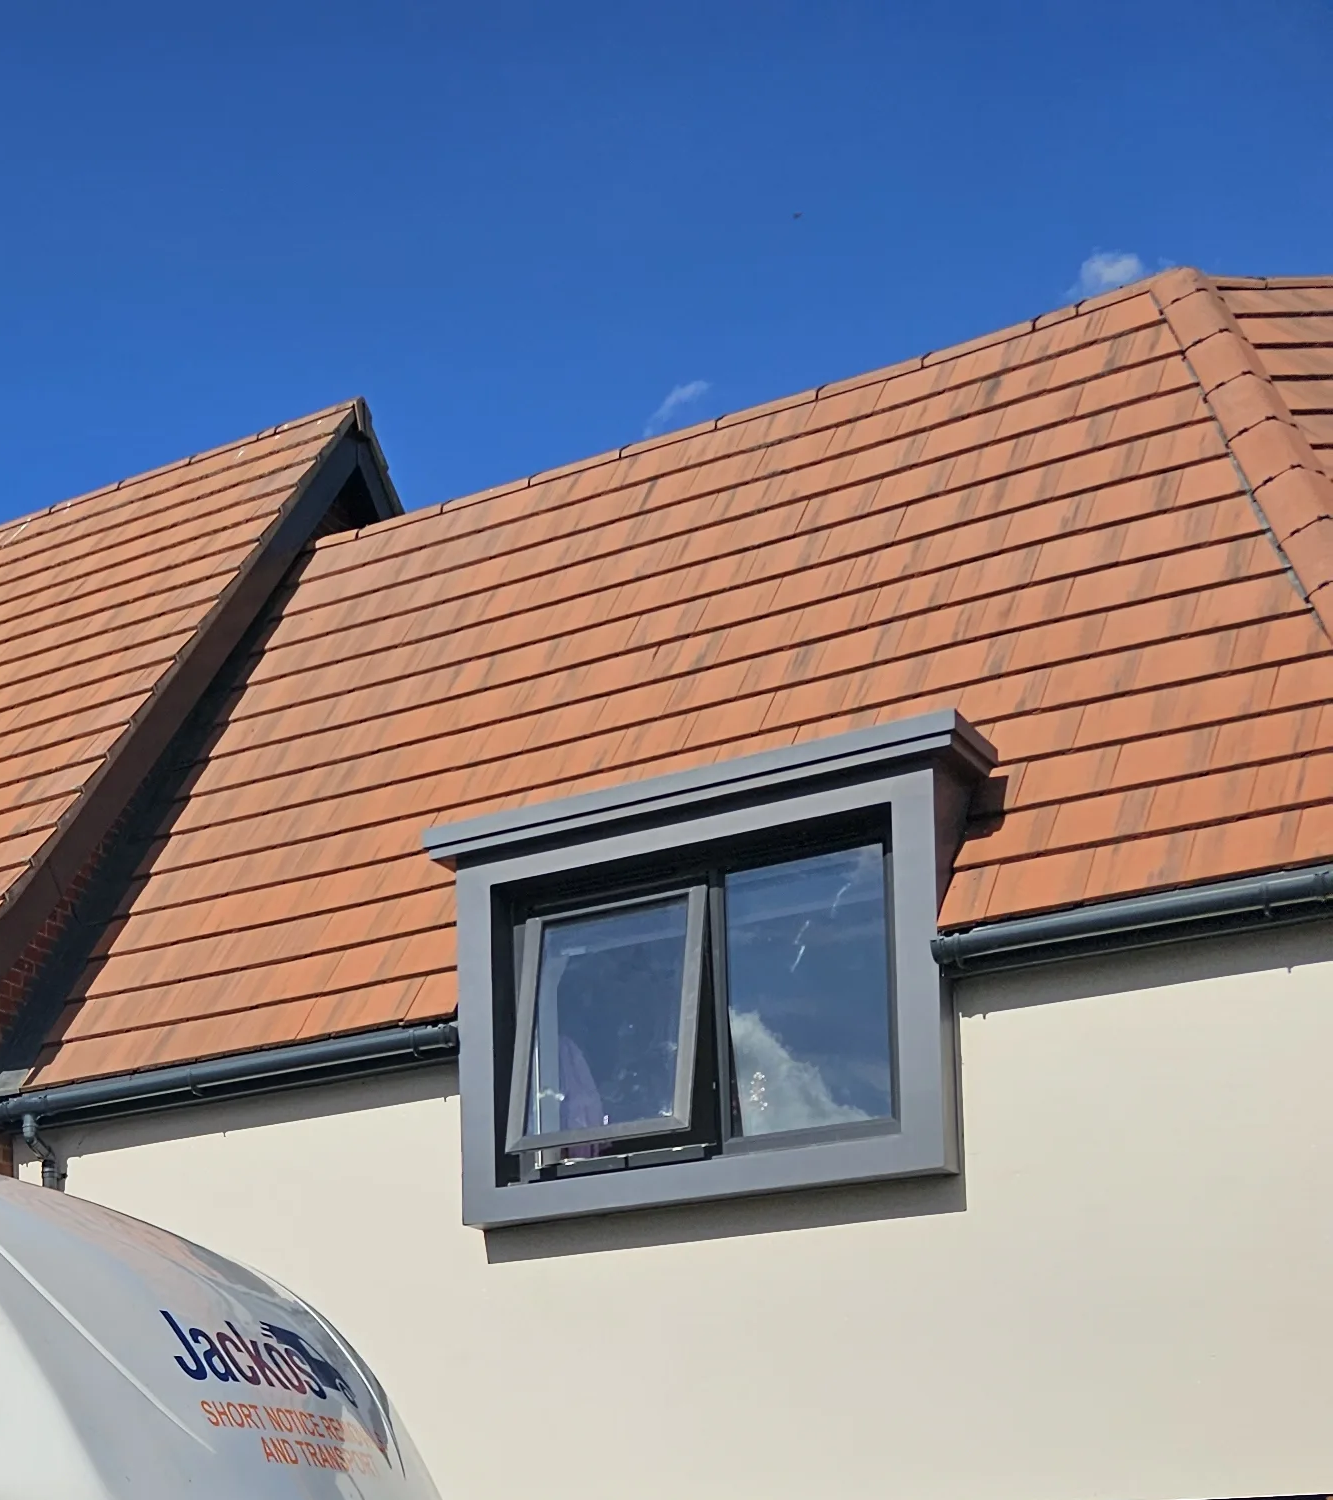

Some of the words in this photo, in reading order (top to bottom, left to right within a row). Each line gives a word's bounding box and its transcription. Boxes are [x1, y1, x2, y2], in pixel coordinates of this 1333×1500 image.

[159, 1309, 327, 1400] Jackos
[201, 1400, 266, 1431] SHORT
[263, 1406, 326, 1439] NOTICE
[261, 1436, 299, 1466] AND
